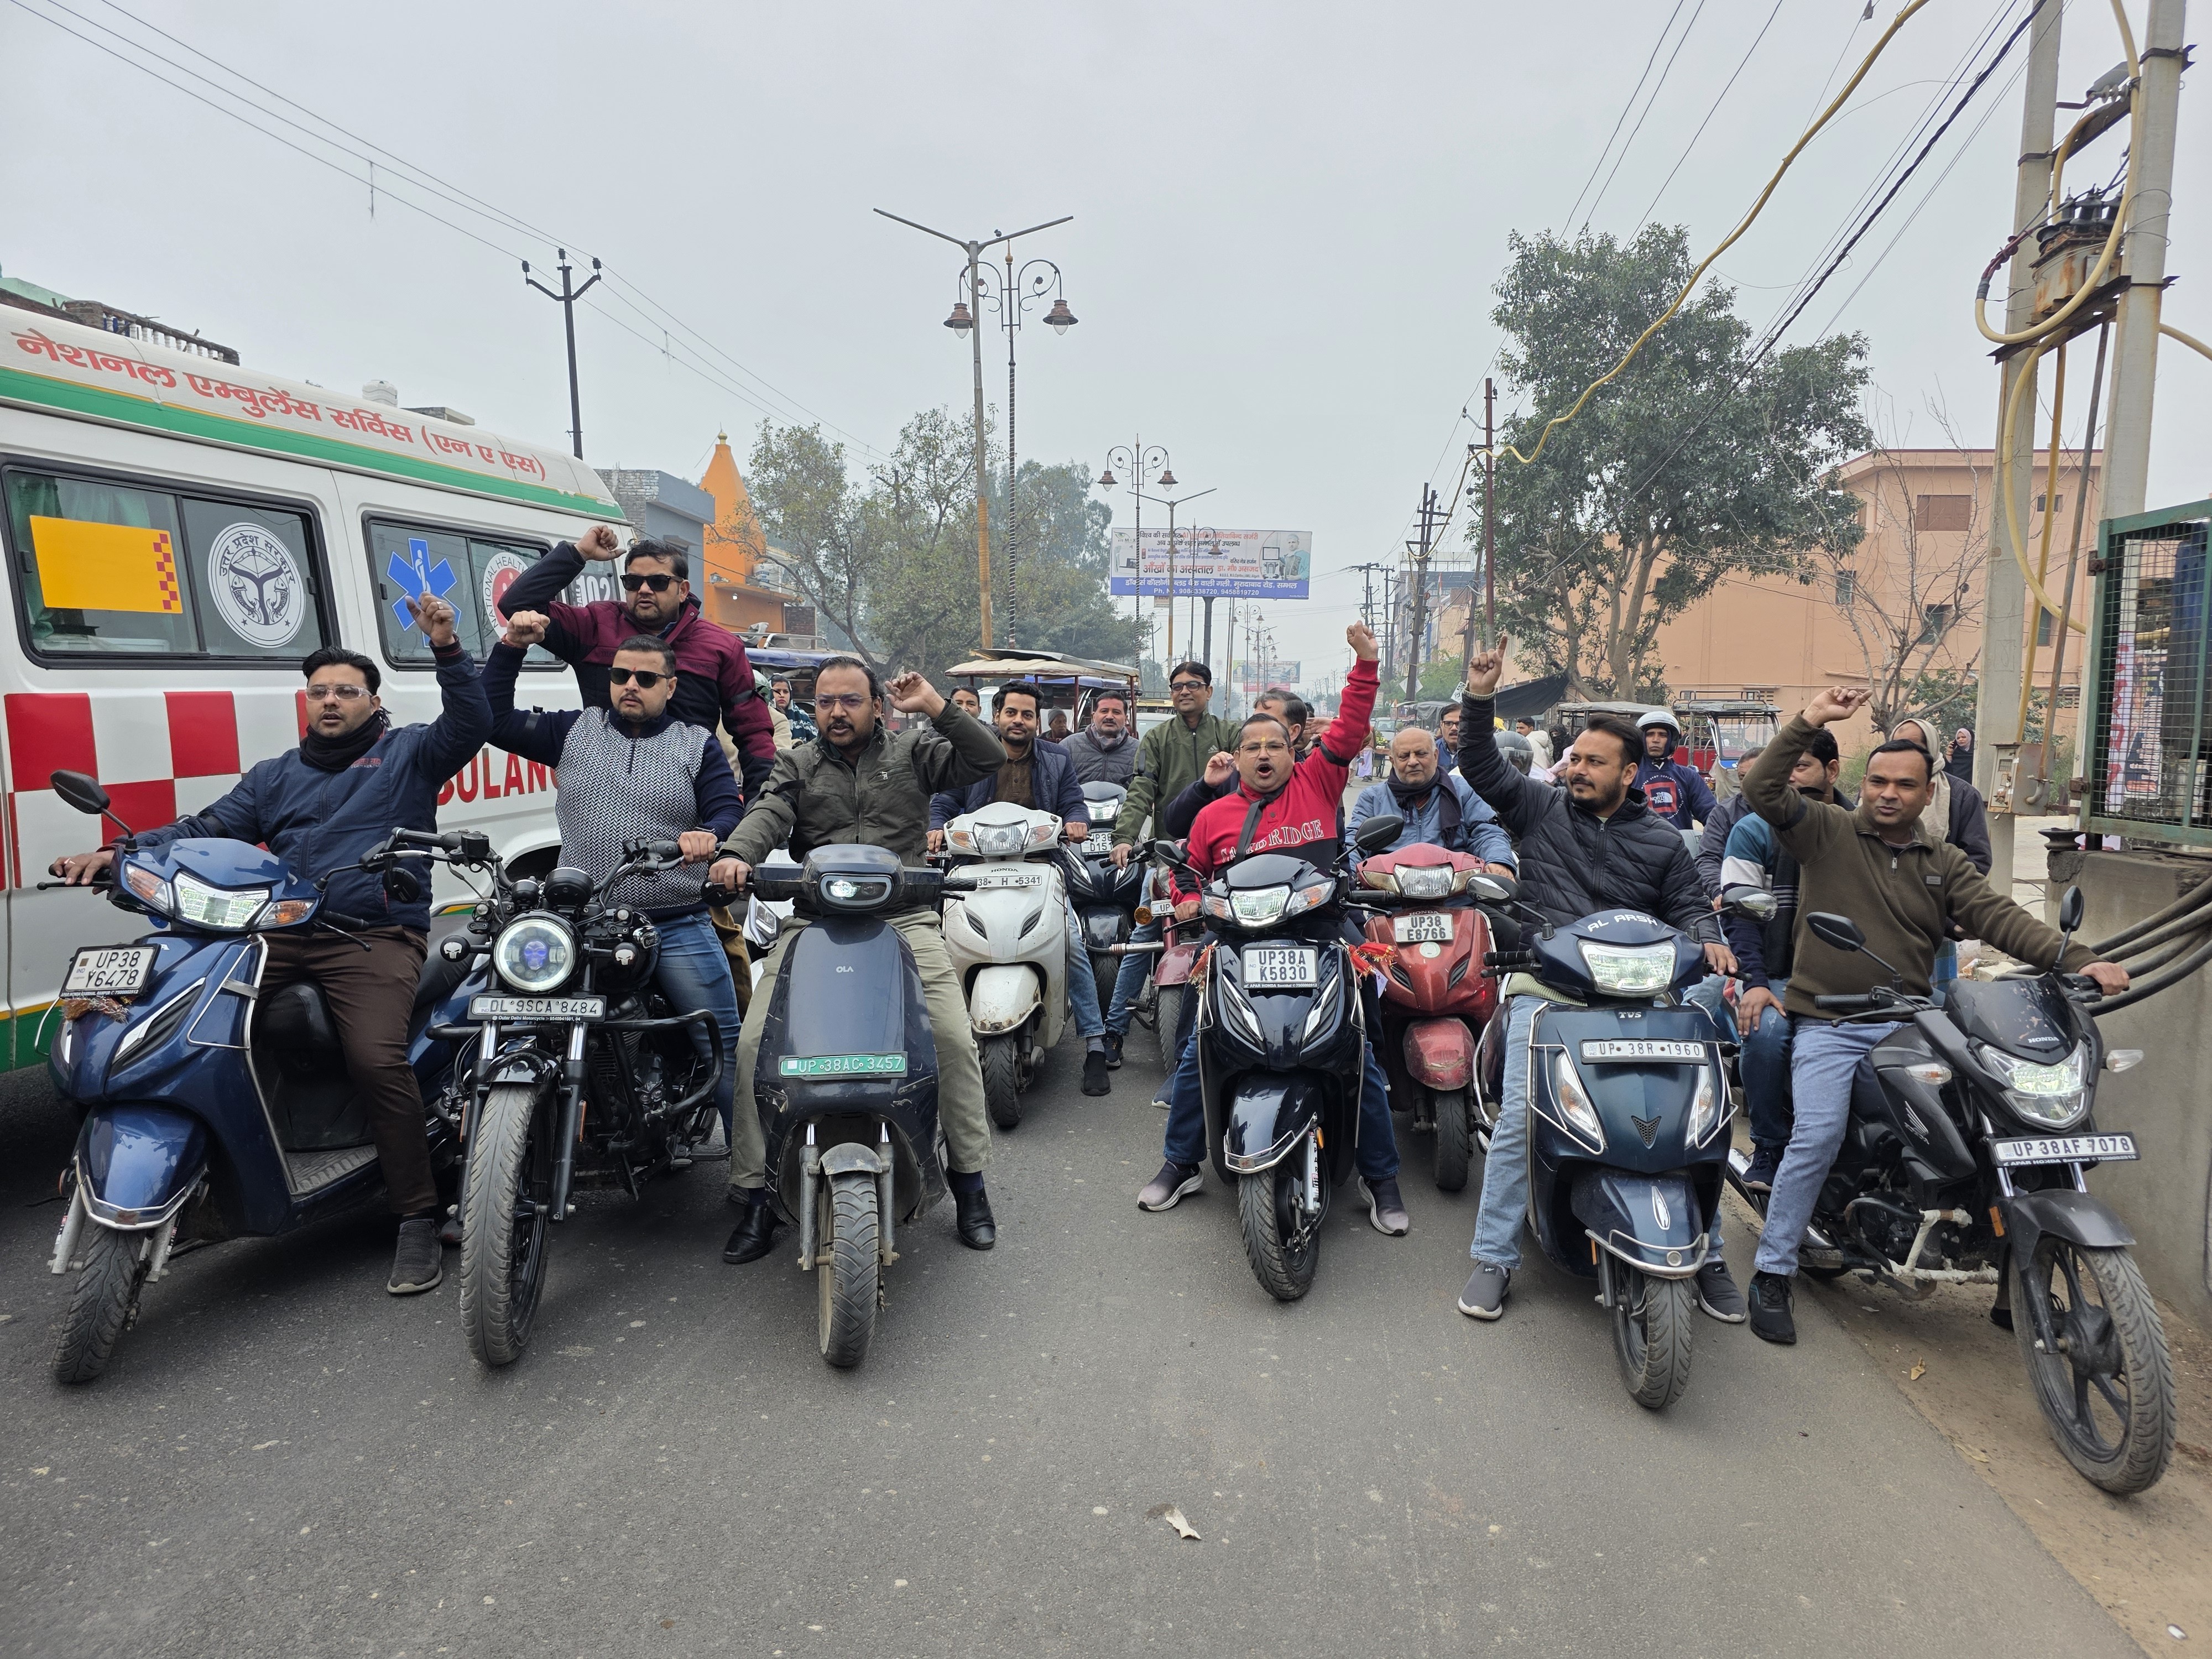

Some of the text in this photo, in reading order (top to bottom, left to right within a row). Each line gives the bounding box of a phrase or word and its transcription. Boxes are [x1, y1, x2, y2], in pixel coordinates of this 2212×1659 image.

[11, 327, 546, 482] नेशनल एम्बुलेंस सर्विस (एन ए एस)
[232, 533, 259, 549] प्रदेश
[1153, 530, 1160, 538] की
[484, 565, 499, 628] NATIONAL
[576, 575, 611, 608] 102
[1001, 877, 1008, 885] H
[1019, 876, 1041, 885] 5341
[1160, 903, 1170, 912] UP
[1411, 916, 1442, 928] UP38
[1587, 914, 1658, 932] AL ARSH
[1407, 927, 1446, 941] E8766
[96, 951, 141, 969] UP38
[1258, 950, 1306, 965] UP38A
[85, 969, 139, 988] Y6478
[1260, 966, 1307, 980] K5830
[489, 999, 508, 1013] DL
[561, 1001, 597, 1014] 8484
[1599, 1042, 1700, 1056] UP 38R 1960
[799, 1056, 903, 1073] UP 38AC 3457
[2012, 1138, 2130, 1157] UP 38AF 7078
